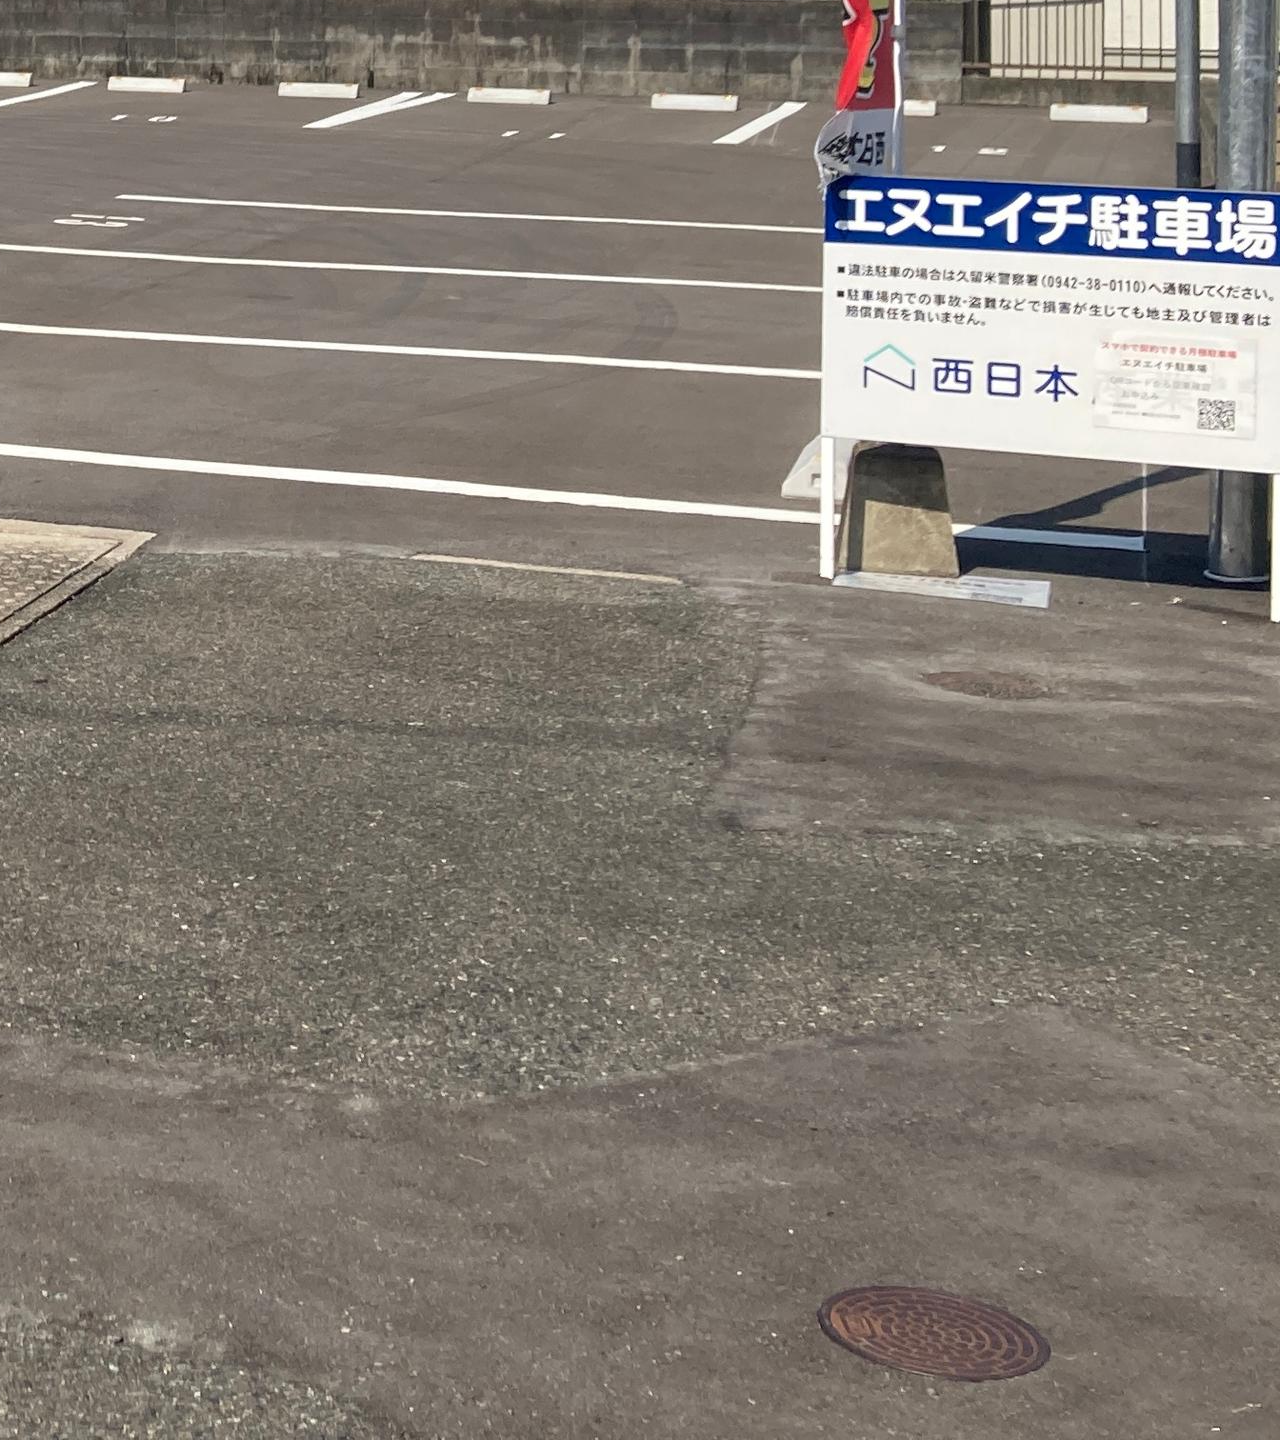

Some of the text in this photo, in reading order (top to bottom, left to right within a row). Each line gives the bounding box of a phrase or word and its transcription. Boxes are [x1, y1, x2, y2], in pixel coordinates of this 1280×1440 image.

[834, 187, 1277, 259] エヌエイチ駐車場
[845, 305, 987, 327] 賠償責任を負いません。
[931, 357, 1079, 402] 西日本
[1120, 359, 1209, 373] エヌエイチ駐車場
